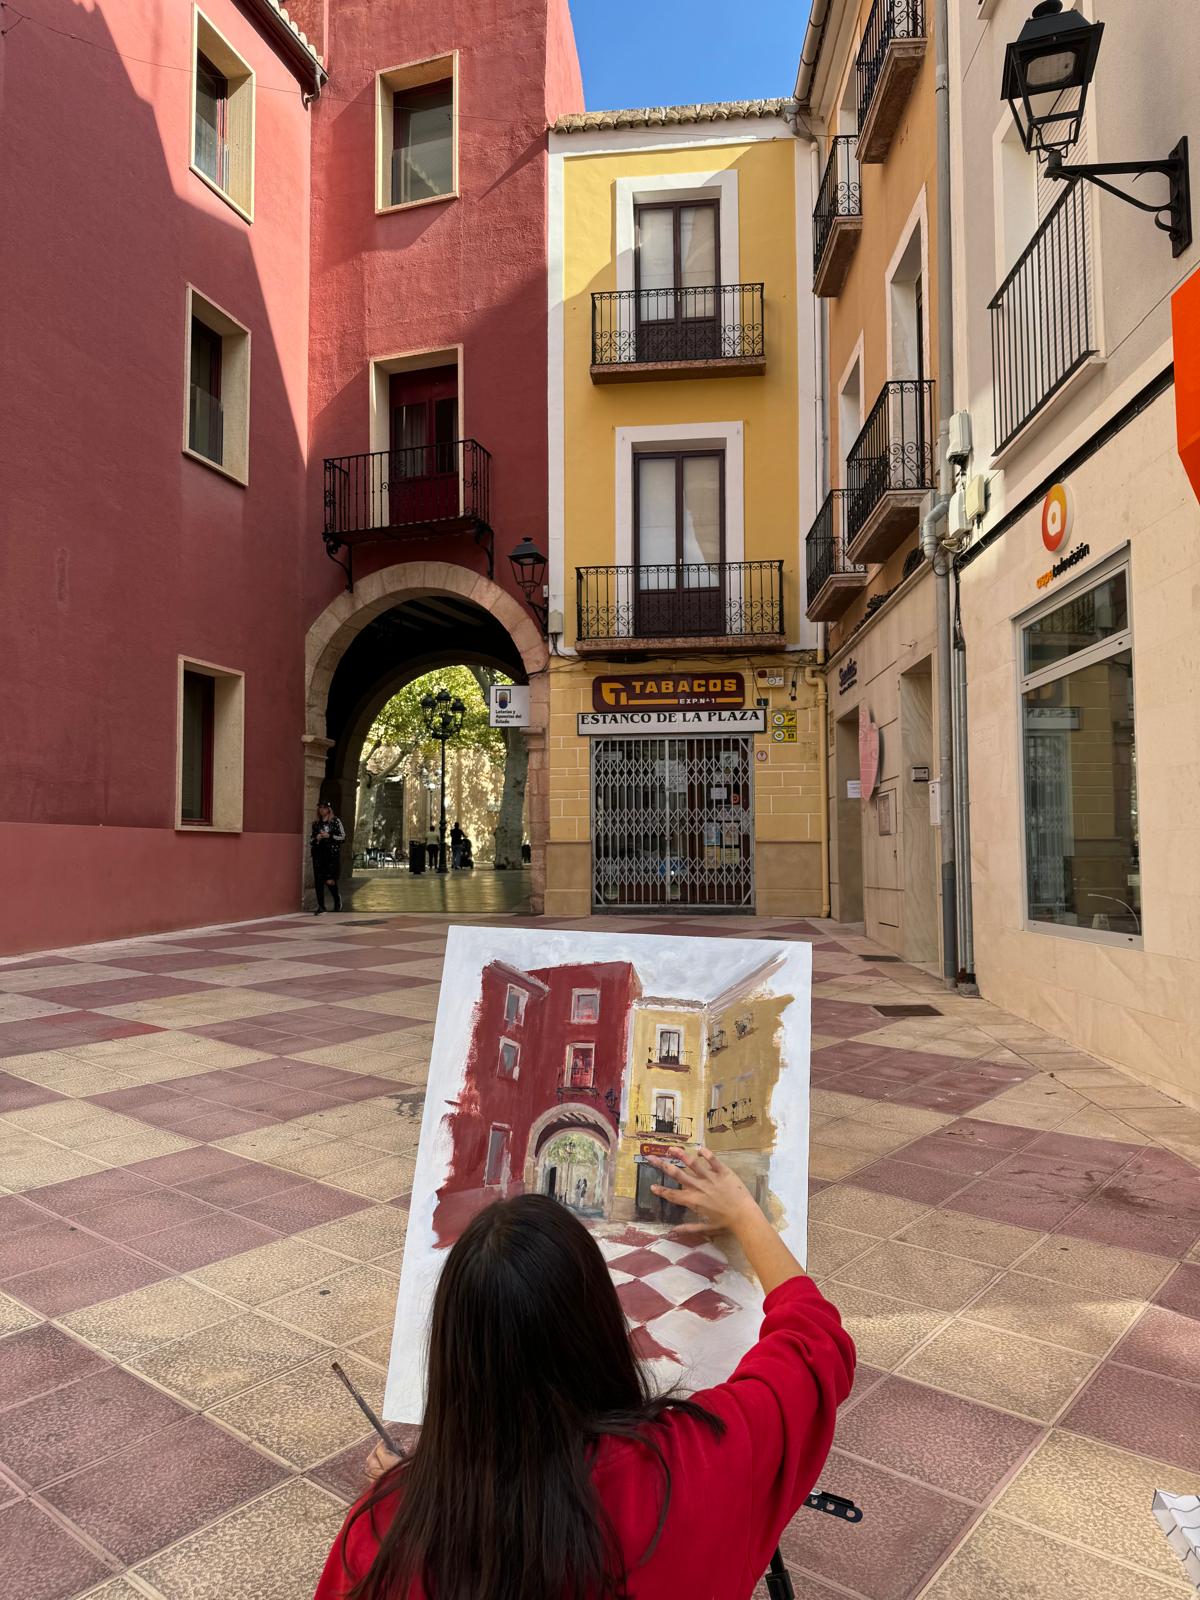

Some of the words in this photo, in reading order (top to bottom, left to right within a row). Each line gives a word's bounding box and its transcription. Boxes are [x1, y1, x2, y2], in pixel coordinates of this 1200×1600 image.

[632, 679, 737, 693] TABACOS
[580, 713, 651, 725] ESTANCO
[657, 712, 677, 723] DE
[682, 712, 702, 723] LA
[707, 710, 760, 722] PLAZA
